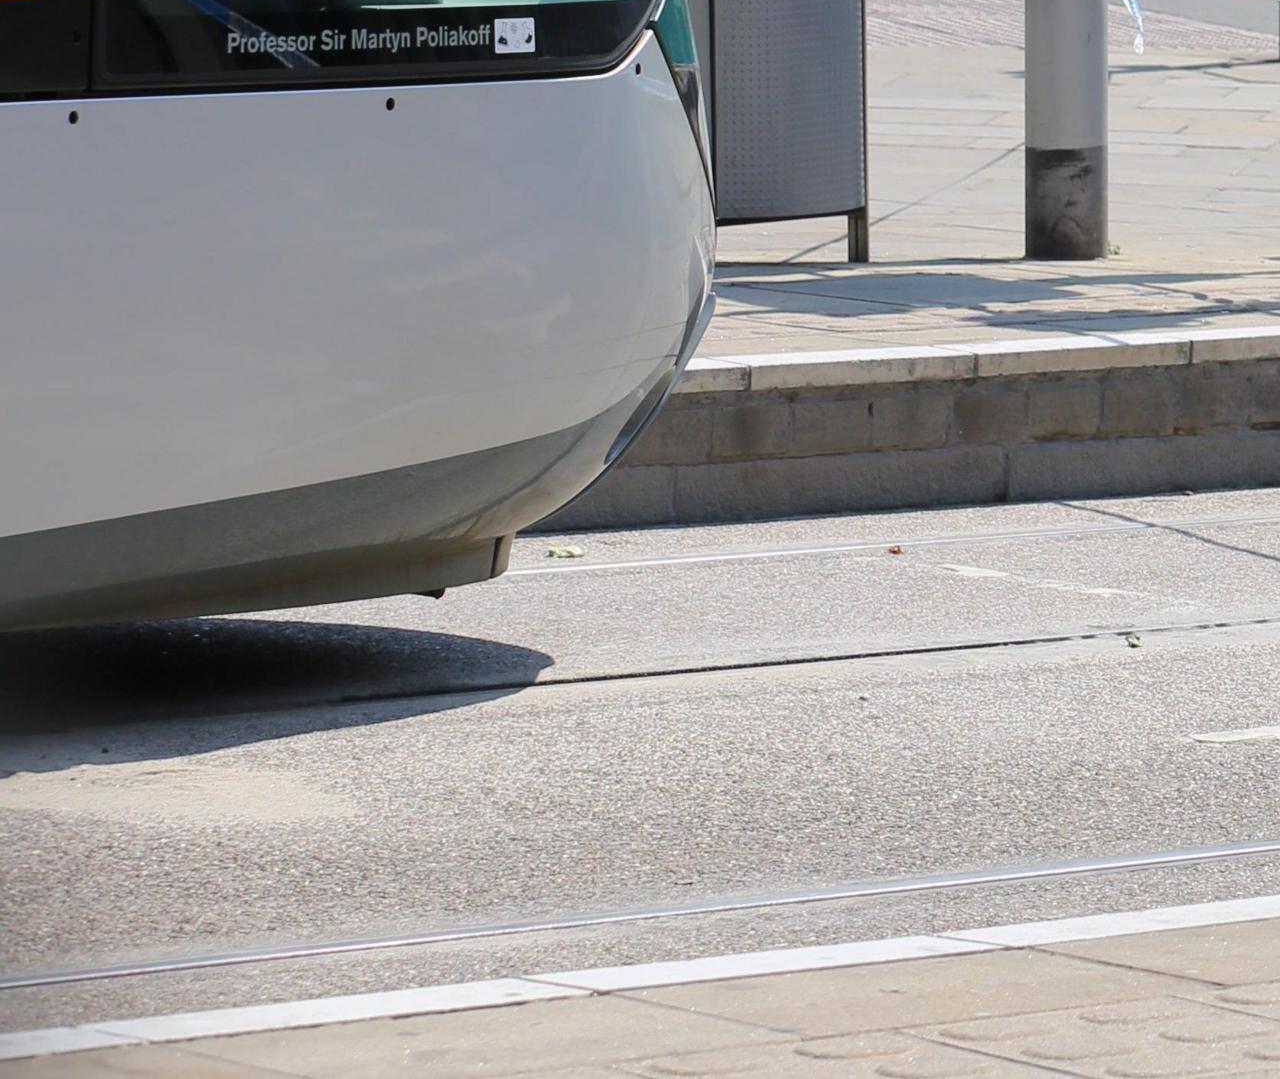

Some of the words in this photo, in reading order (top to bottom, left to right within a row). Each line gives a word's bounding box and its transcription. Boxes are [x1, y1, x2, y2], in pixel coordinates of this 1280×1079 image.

[227, 32, 316, 53] Professor
[320, 29, 346, 51] Sir
[351, 27, 411, 53] Martyn
[416, 24, 491, 48] Poliakoff
